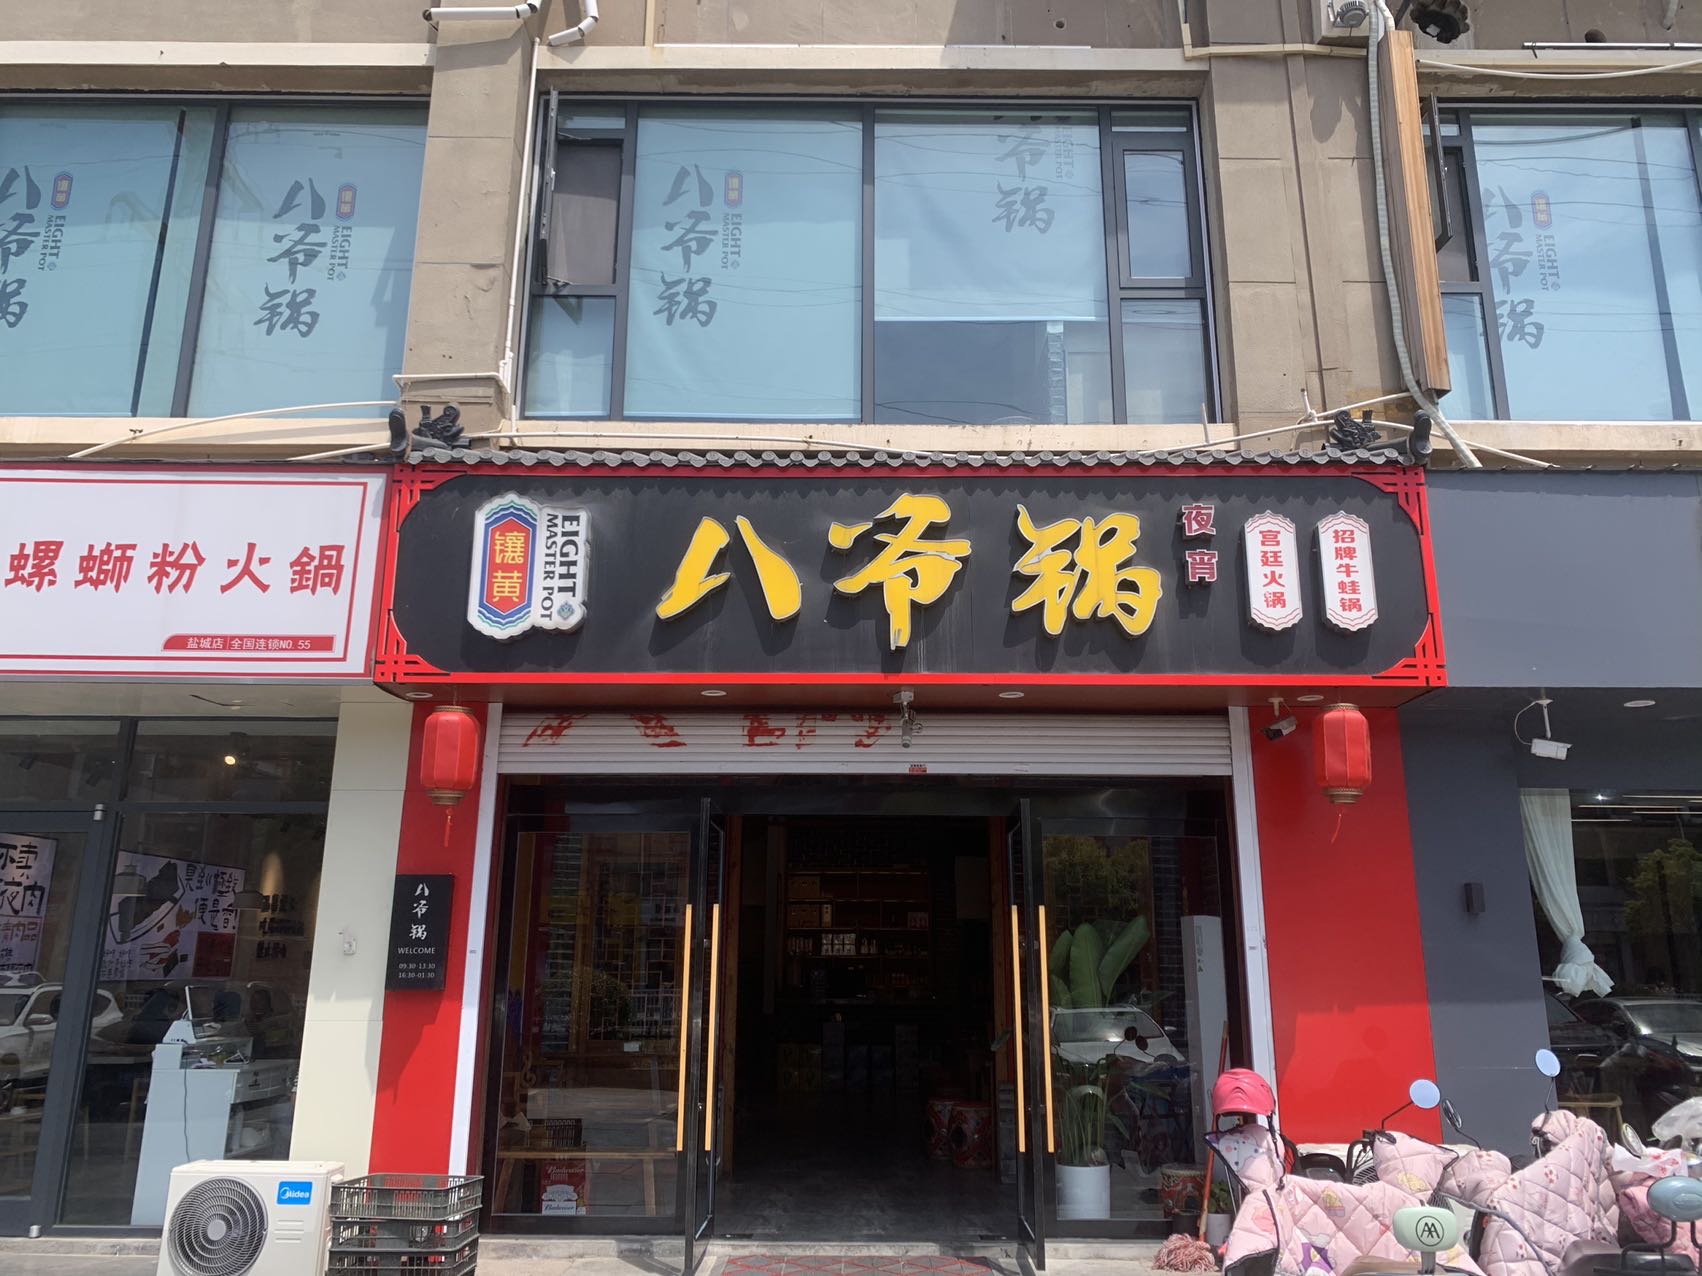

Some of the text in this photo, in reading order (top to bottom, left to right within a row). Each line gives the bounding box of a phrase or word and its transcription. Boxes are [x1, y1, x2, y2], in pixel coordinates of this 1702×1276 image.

[992, 122, 1055, 234] 爷锅
[38, 214, 53, 271] MASTER POT
[48, 215, 67, 260] EIGHT
[253, 177, 328, 338] 八爷锅
[326, 225, 341, 281] MASTER POT
[337, 226, 353, 270] EIGHT
[653, 163, 718, 327] 八爷锅
[720, 212, 730, 270] MASTER POT
[730, 213, 742, 257] EIGHT
[1535, 233, 1547, 272] MASTER
[1543, 234, 1560, 279] EIGHT
[1539, 272, 1550, 291] POT
[540, 513, 560, 621] MASTER POT
[557, 514, 580, 597] EIGHT
[655, 492, 1163, 650] 八爷锅
[1182, 503, 1219, 582] 夜宵
[1258, 529, 1287, 609] 宫廷火锅
[1332, 528, 1363, 613] 招牌牛蛙锅
[186, 636, 224, 650] 盐城店
[409, 882, 430, 940] 八爷锅
[397, 947, 436, 955] WELCOME
[279, 1186, 310, 1200] Midea
